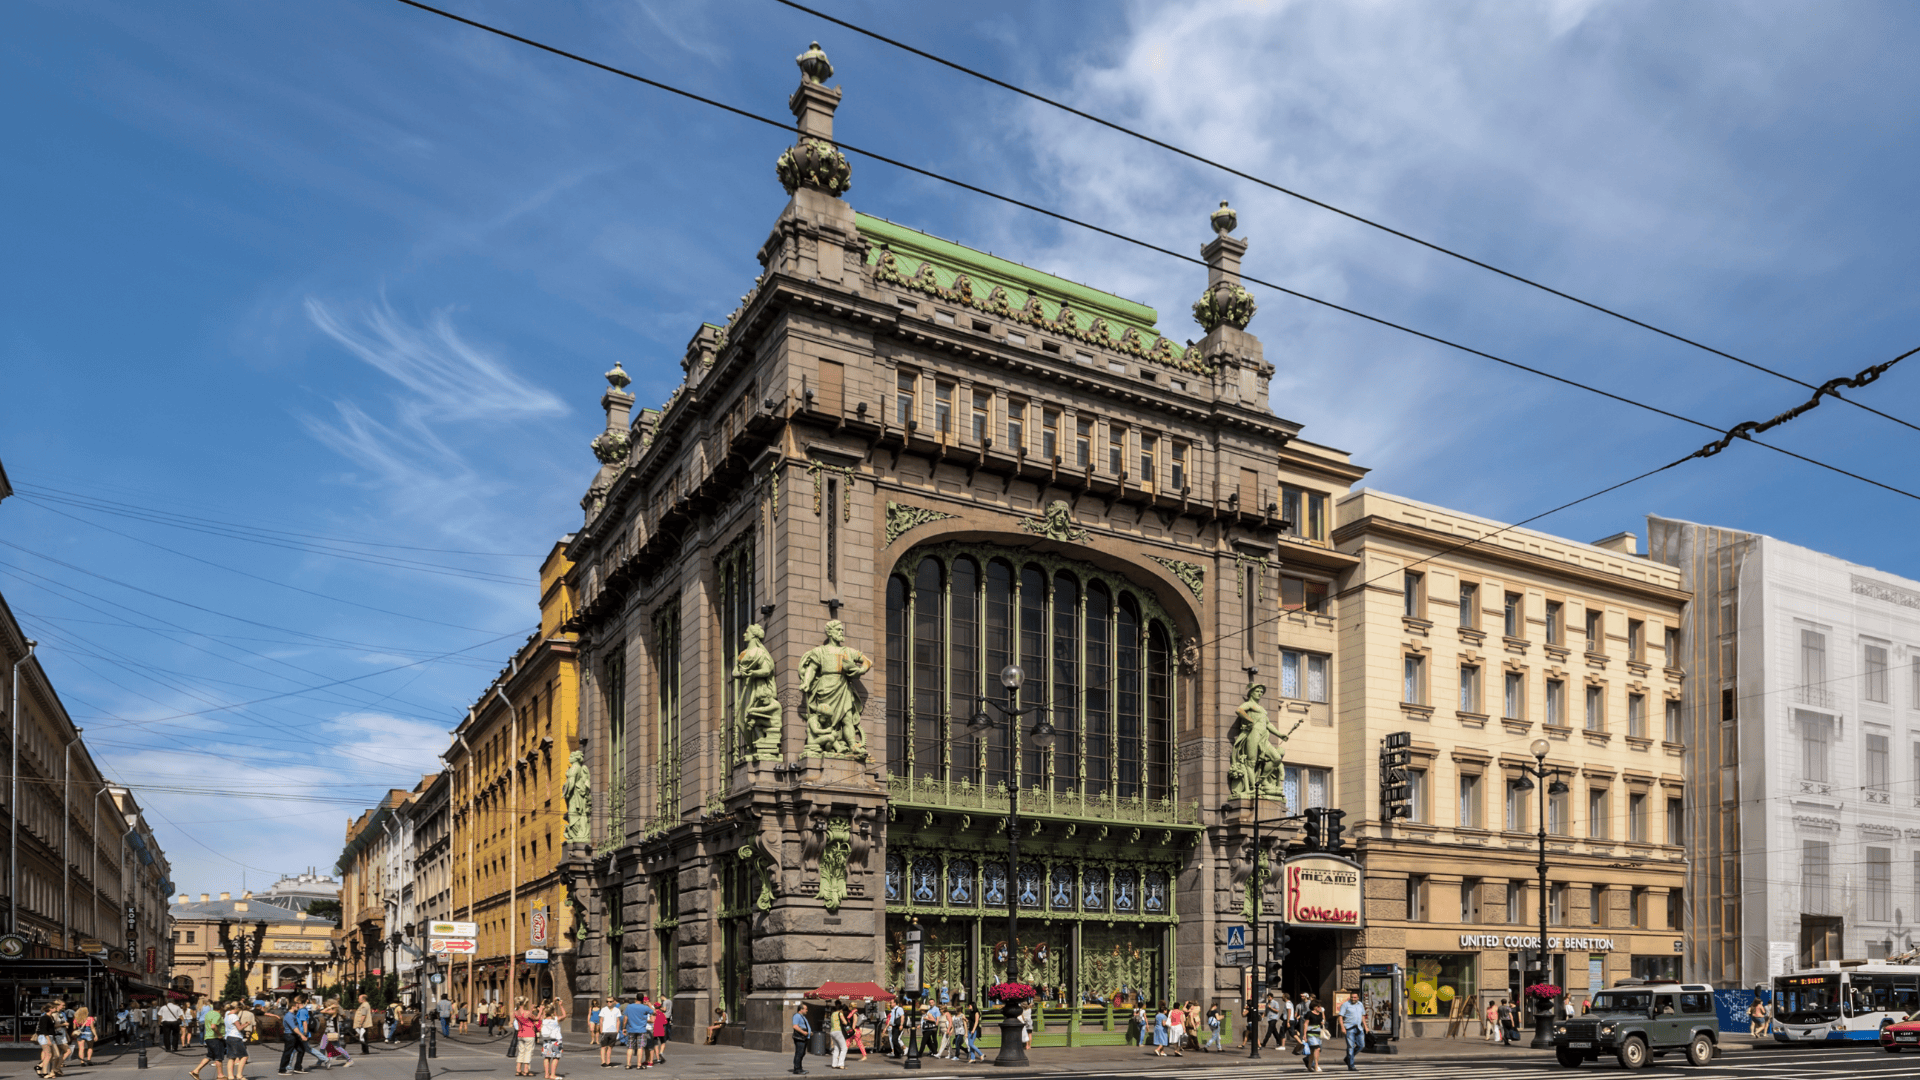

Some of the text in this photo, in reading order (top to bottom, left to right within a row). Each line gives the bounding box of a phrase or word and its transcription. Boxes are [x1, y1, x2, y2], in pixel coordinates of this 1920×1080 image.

[1460, 934, 1614, 949] UNITED COLORS OF BENETTON
